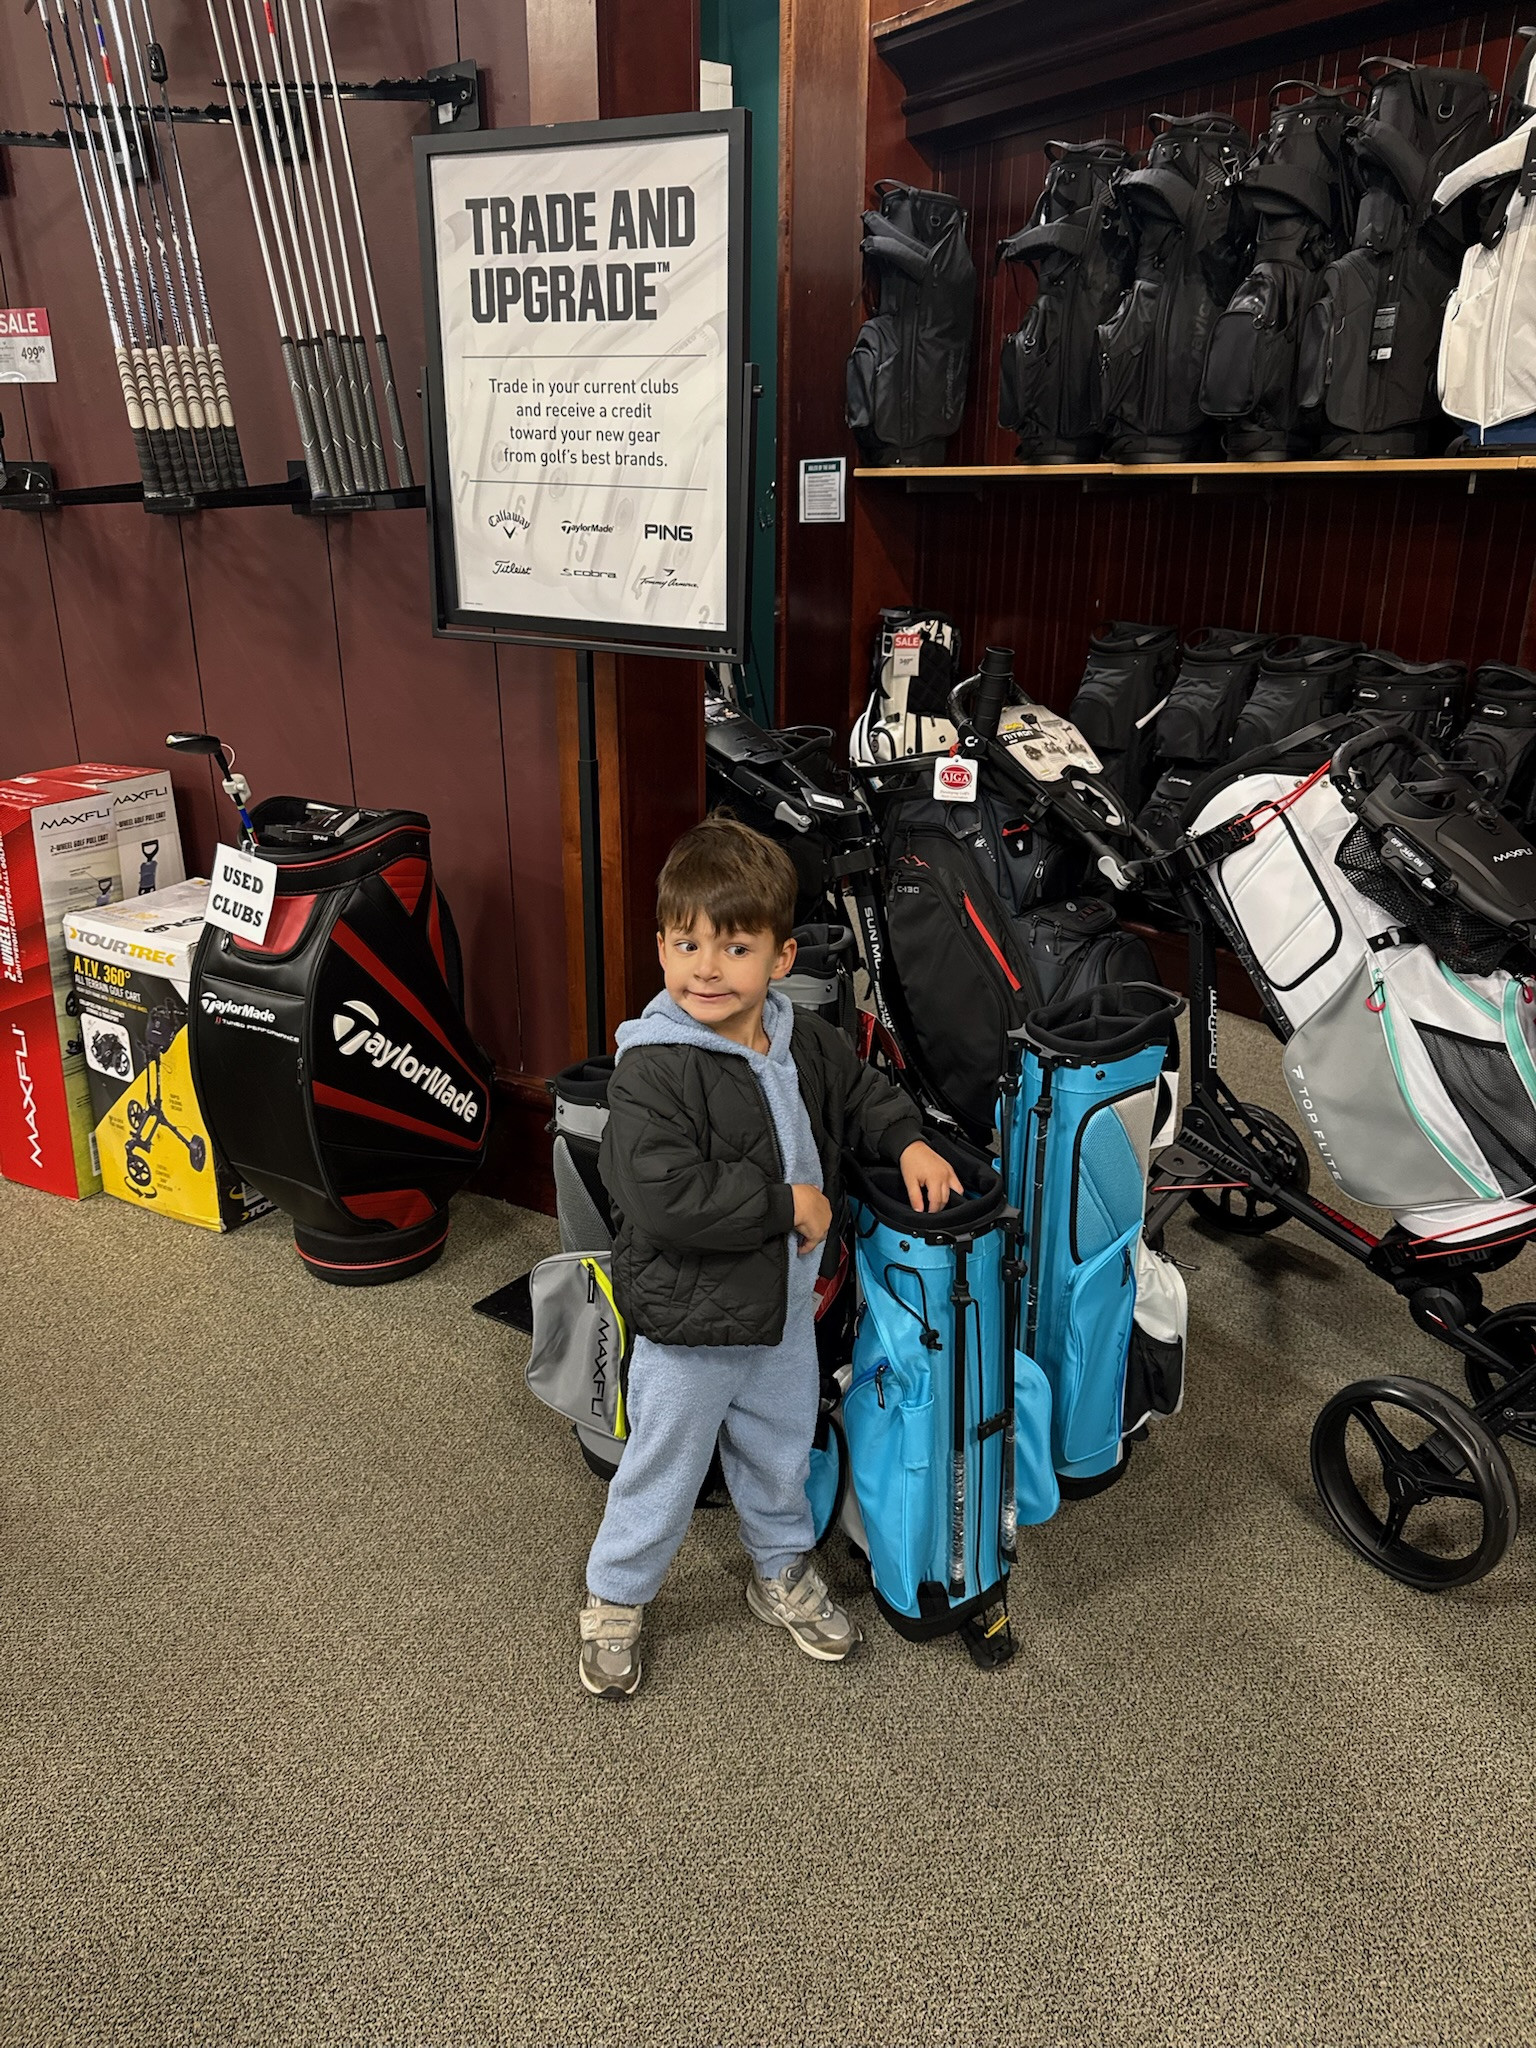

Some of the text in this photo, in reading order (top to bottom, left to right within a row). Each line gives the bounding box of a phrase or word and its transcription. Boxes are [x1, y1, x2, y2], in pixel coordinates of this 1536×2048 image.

[465, 186, 696, 255] TRADE AND
[0, 312, 39, 334] SALE
[489, 378, 679, 397] Trade in your current clubs
[516, 402, 652, 418] and receive a credit
[510, 426, 660, 446] toward your new gear
[504, 448, 668, 467] from golf's best brands.
[488, 509, 531, 530] Callaway
[561, 520, 613, 534] TaylorMade
[645, 524, 693, 541] PING
[492, 560, 532, 575] Titleist
[574, 569, 617, 578] cobra
[895, 636, 919, 647] SALE
[942, 772, 969, 782] AJGA
[40, 808, 110, 830] MAXFLI
[223, 865, 264, 894] USED
[212, 894, 263, 927] CLUBS
[864, 906, 878, 942] SUN
[74, 955, 132, 988] A.T.V. 360°
[109, 985, 124, 998] GOLF
[125, 990, 142, 1003] CART
[201, 992, 276, 1023] TaylorMade
[333, 1000, 478, 1123] TaylorMade
[12, 1027, 43, 1168] MAXFLI
[1299, 1086, 1342, 1181] TOP FLITE
[591, 1317, 610, 1418] MAXFLI
